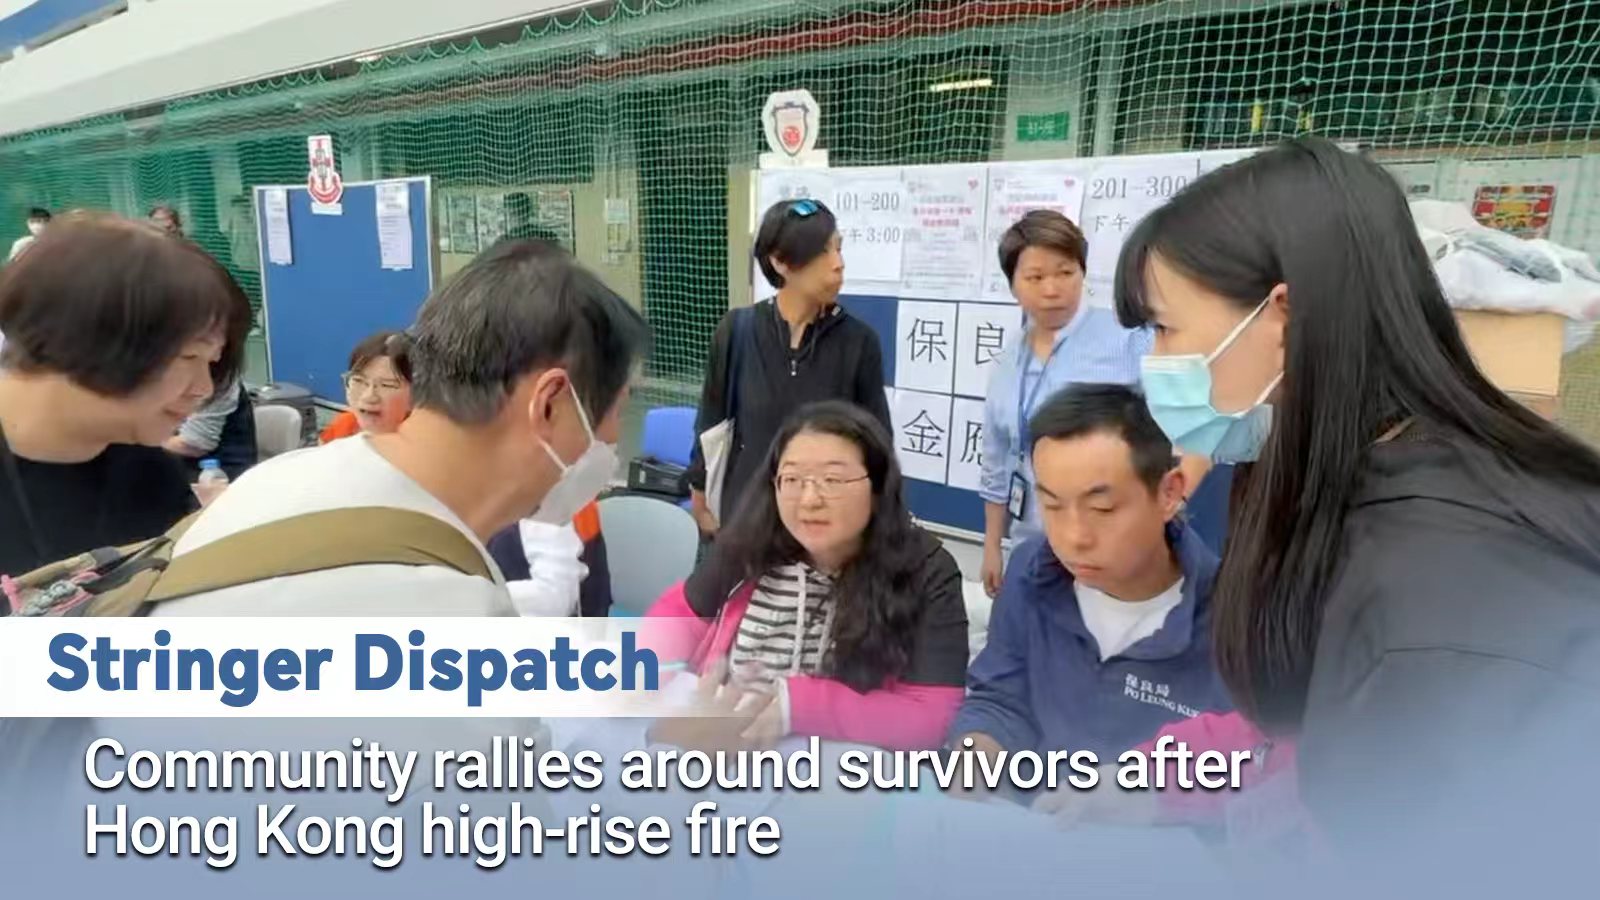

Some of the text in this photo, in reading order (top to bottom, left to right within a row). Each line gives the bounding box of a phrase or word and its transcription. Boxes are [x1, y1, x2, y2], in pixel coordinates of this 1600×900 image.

[835, 191, 900, 211] 101-200
[1089, 213, 1130, 233] 下午
[866, 227, 900, 243] 3:00
[1125, 673, 1169, 698] 保良局
[1124, 686, 1139, 700] PO
[1140, 691, 1177, 711] LEUNG
